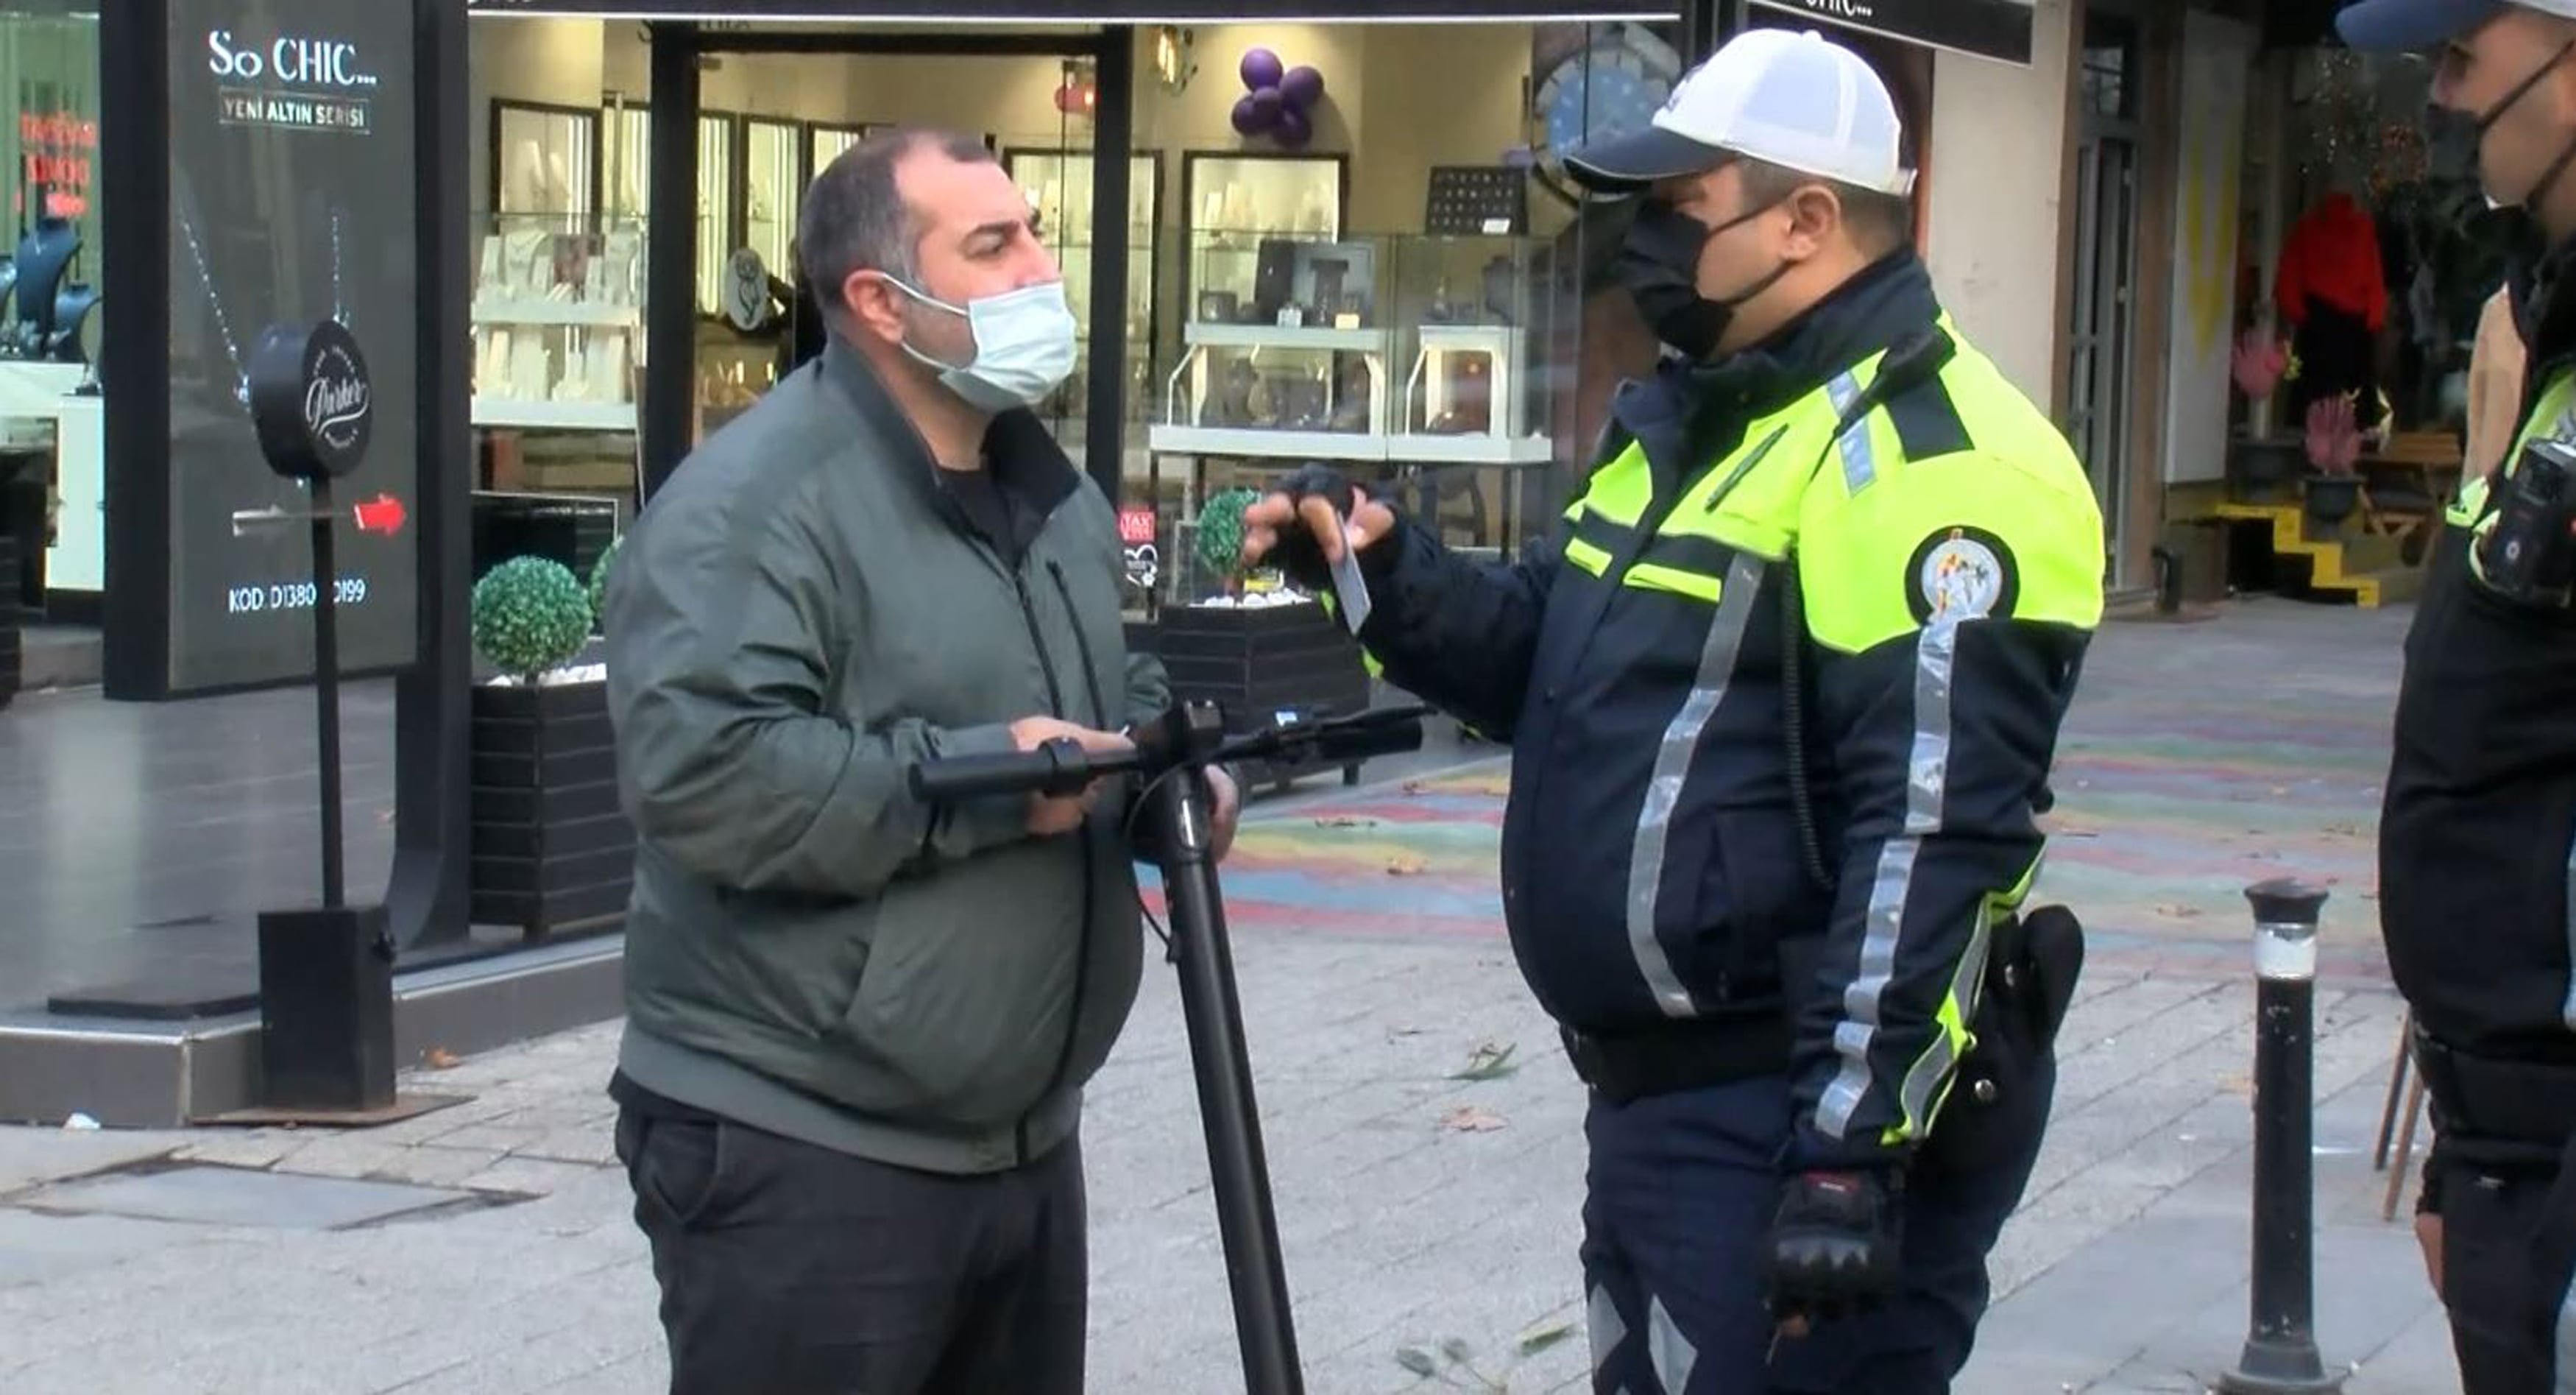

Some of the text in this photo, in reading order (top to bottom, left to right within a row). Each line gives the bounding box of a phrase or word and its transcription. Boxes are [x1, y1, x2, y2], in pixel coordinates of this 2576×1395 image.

[209, 30, 377, 85] So CHIC...
[224, 96, 263, 120] YENİ
[266, 101, 312, 124] ALTIN
